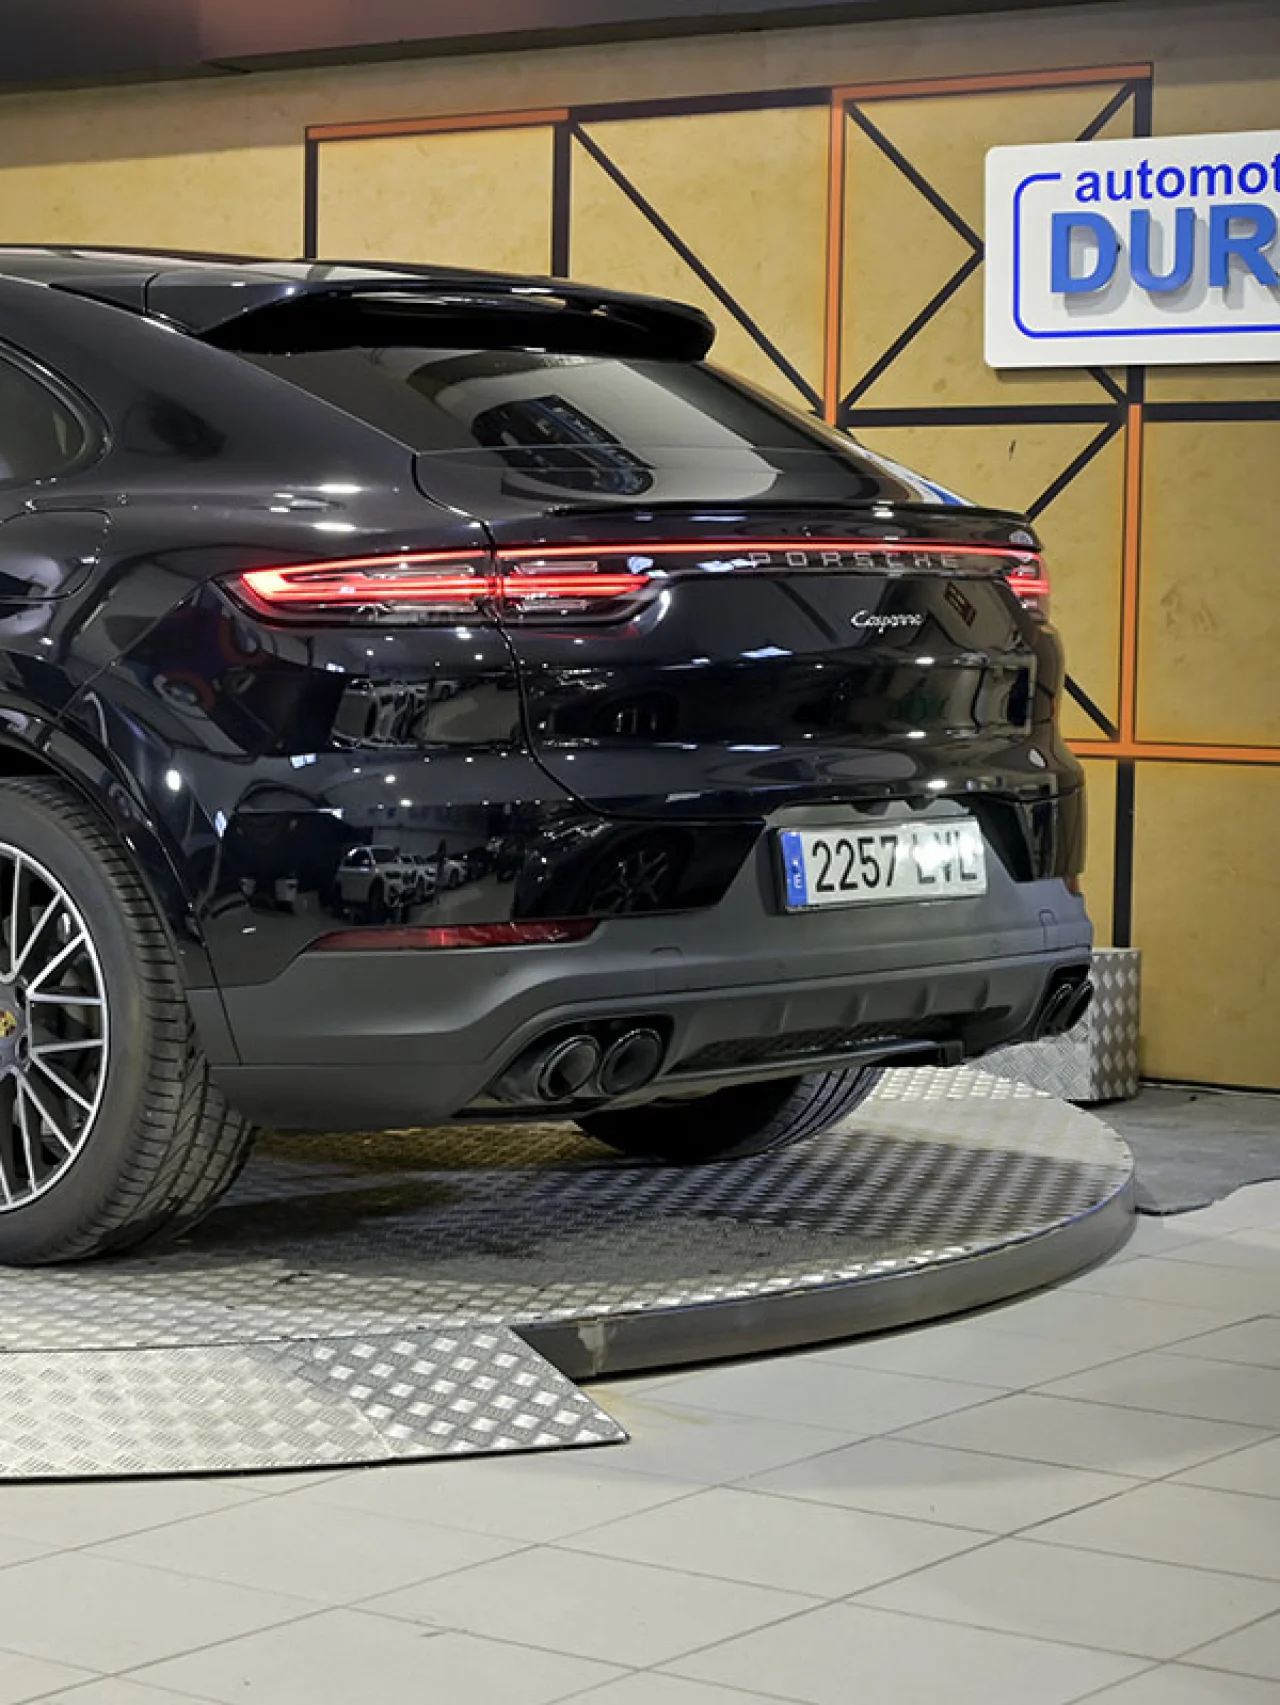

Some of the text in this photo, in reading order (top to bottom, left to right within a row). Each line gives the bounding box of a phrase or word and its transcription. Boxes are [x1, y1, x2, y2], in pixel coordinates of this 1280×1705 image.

[1050, 202, 1280, 294] DUR
[748, 550, 960, 569] PORSCHE
[850, 609, 924, 635] Cayenne
[812, 835, 898, 893] 2257
